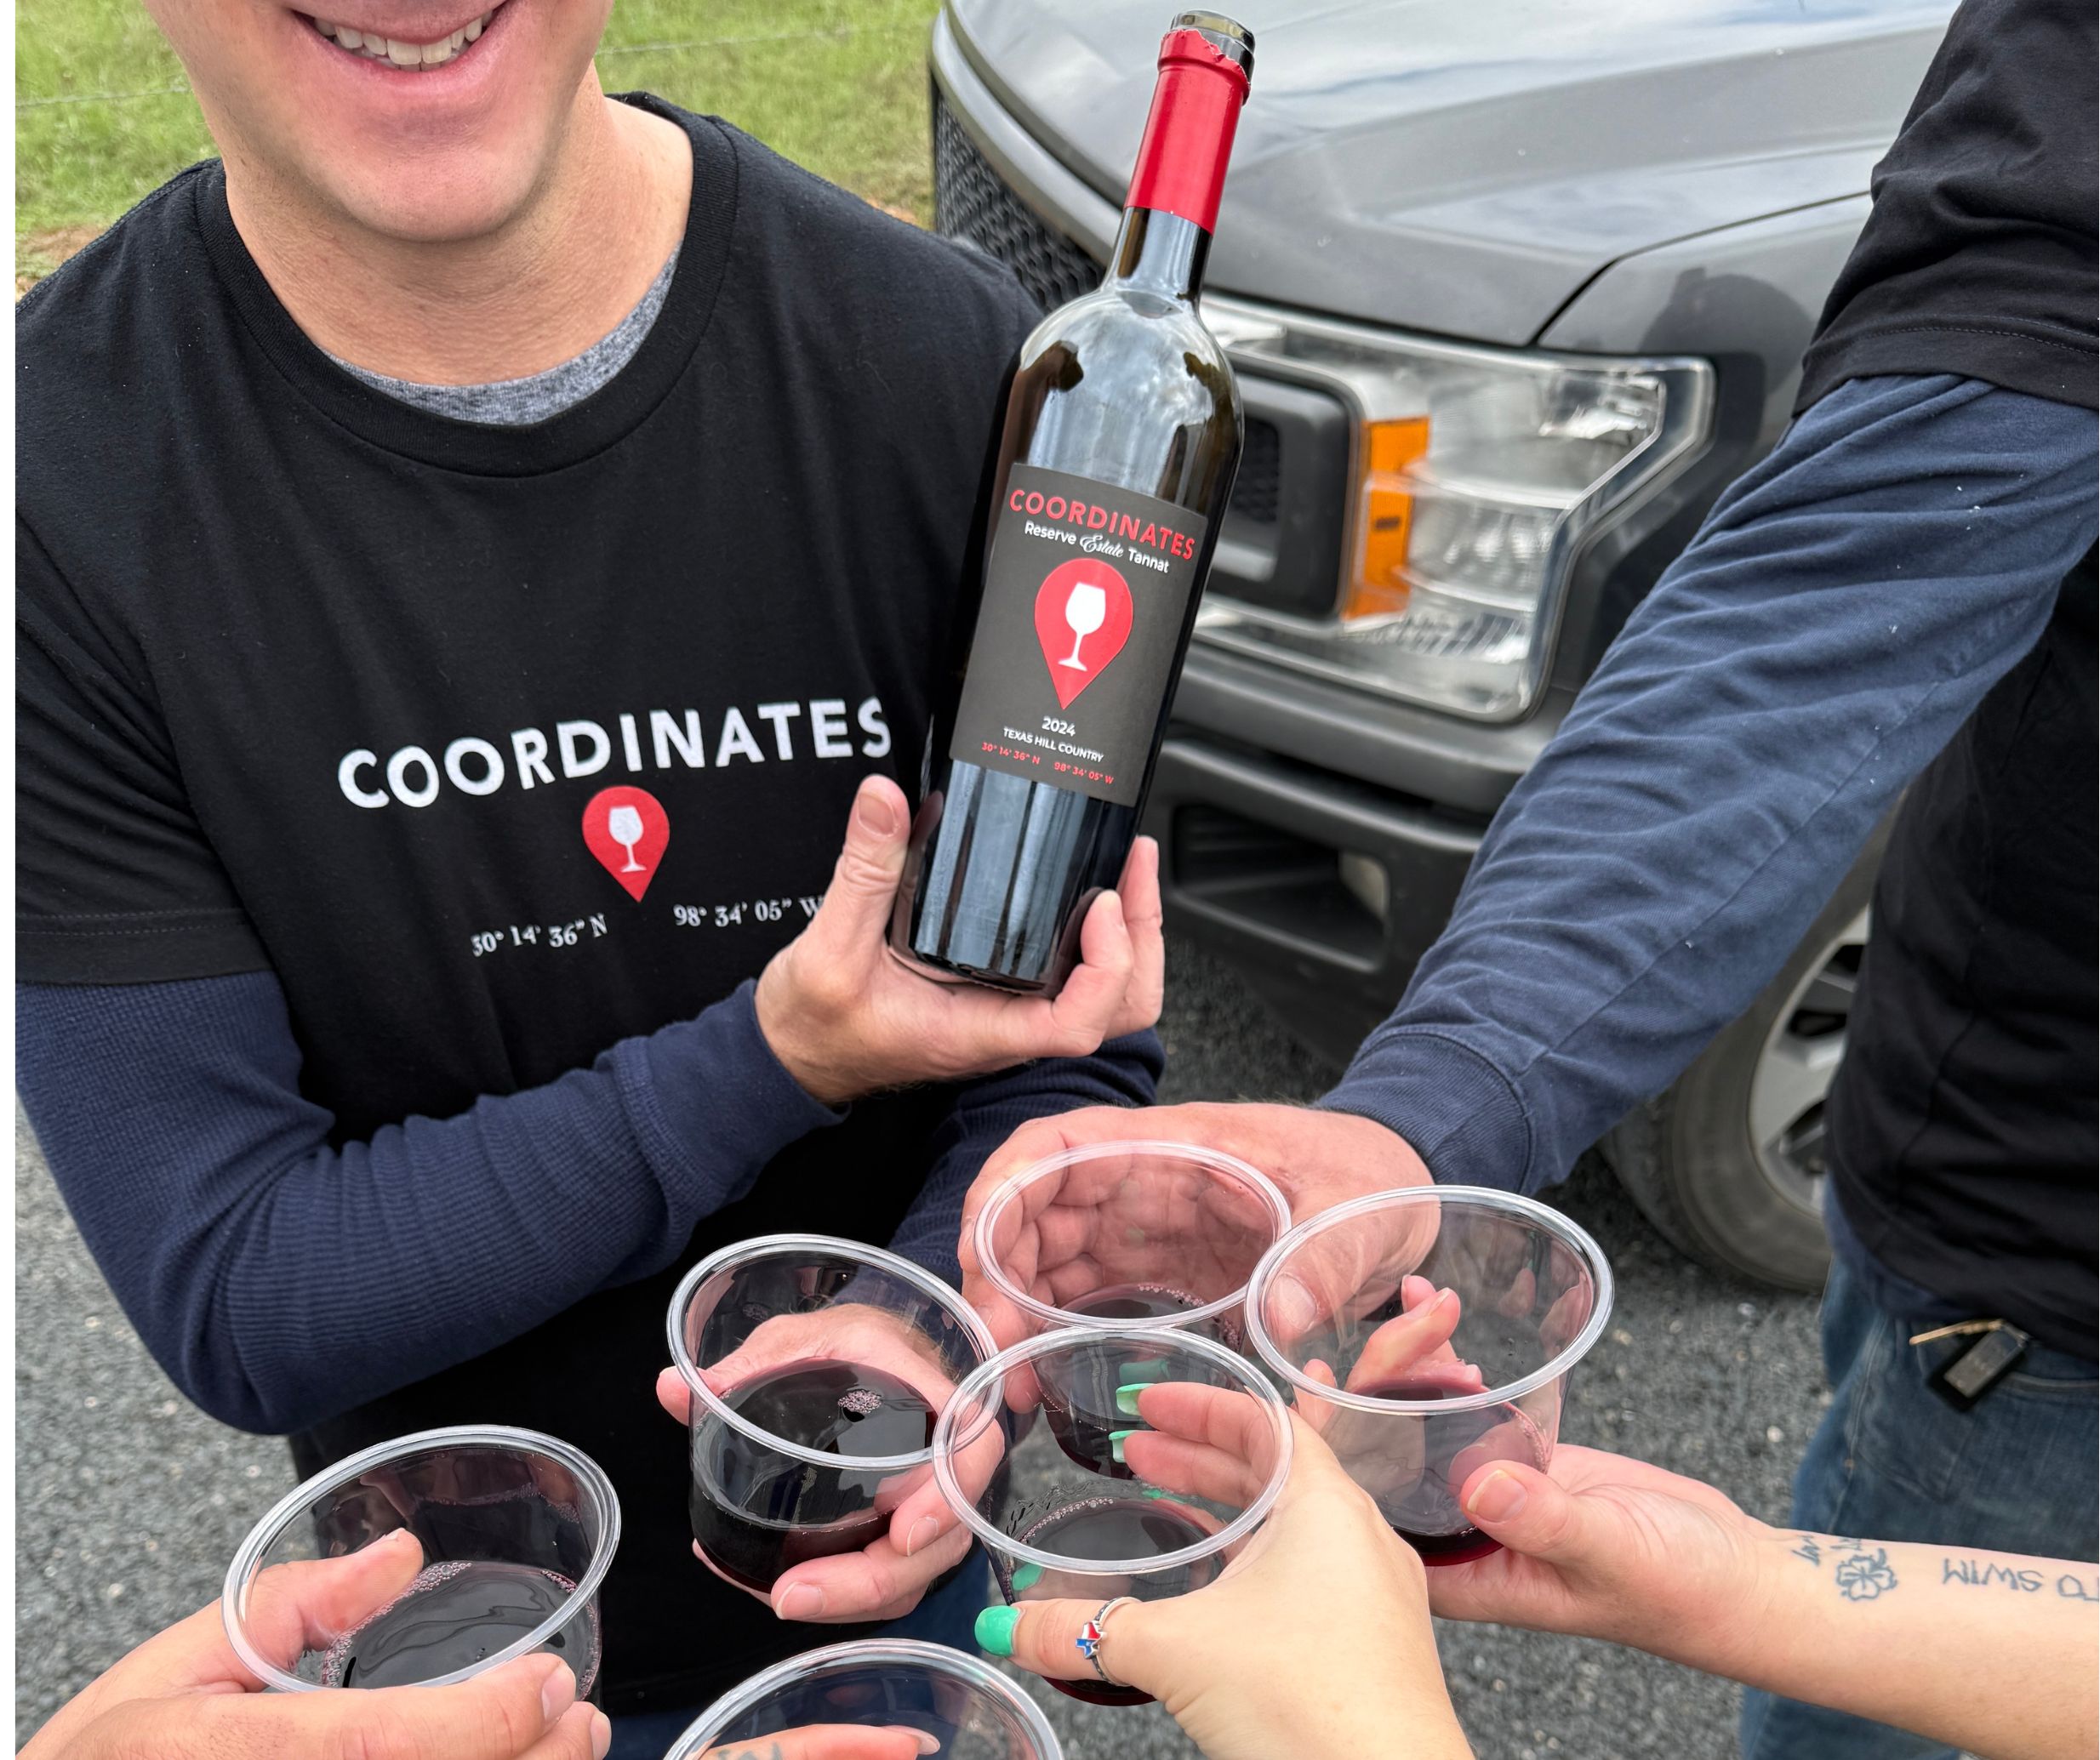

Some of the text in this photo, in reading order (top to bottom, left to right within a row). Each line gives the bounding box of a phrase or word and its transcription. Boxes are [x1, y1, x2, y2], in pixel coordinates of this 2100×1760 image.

[1009, 489, 1195, 561] COORDINATES
[1024, 520, 1170, 573] Reserve Estate Tannat
[1002, 726, 1104, 763] TEXAS HILL COUNTRY
[1041, 715, 1076, 738] 2024
[338, 698, 891, 808] COORDINATES
[982, 742, 997, 752] 30°
[1032, 756, 1041, 765] N
[1053, 761, 1071, 772] 98°
[1104, 775, 1114, 784] W
[510, 924, 541, 946] 14'
[589, 913, 608, 937] N
[673, 903, 707, 927] 98°
[714, 901, 748, 927] 34'
[1941, 1558, 2044, 1592] SWIM
